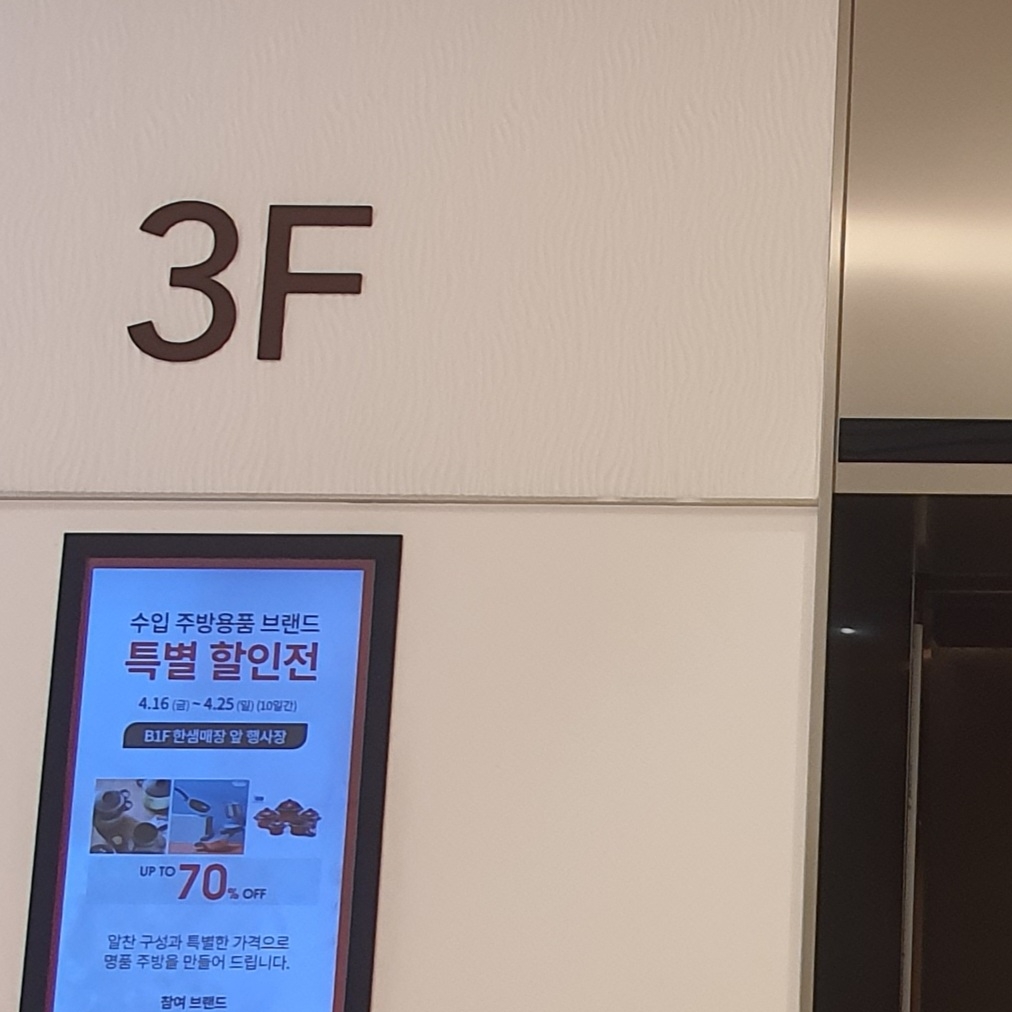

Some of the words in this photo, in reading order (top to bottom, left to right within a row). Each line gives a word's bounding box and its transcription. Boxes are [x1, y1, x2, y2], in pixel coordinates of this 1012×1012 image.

[127, 200, 373, 362] 3F
[130, 612, 170, 634] 수입
[175, 612, 255, 634] 주방용품
[260, 613, 321, 634] 브랜드
[124, 640, 198, 681] 특별
[210, 641, 319, 681] 할인전
[138, 697, 169, 711] 4.16
[203, 697, 234, 711] 4.25
[246, 729, 287, 744] 행사장
[140, 866, 156, 877] UP
[159, 866, 176, 877] TO
[243, 888, 267, 899] OFF
[108, 934, 136, 950] 알찬
[139, 934, 182, 950] 구성과
[186, 934, 229, 950] 특별한
[232, 934, 289, 950] 가격으로
[104, 954, 132, 970] 명품
[136, 954, 179, 970] 주방을
[183, 954, 226, 970] 만들어
[228, 954, 290, 970] 드립니다.
[160, 995, 187, 1010] 참여
[188, 995, 228, 1009] 브랜드
